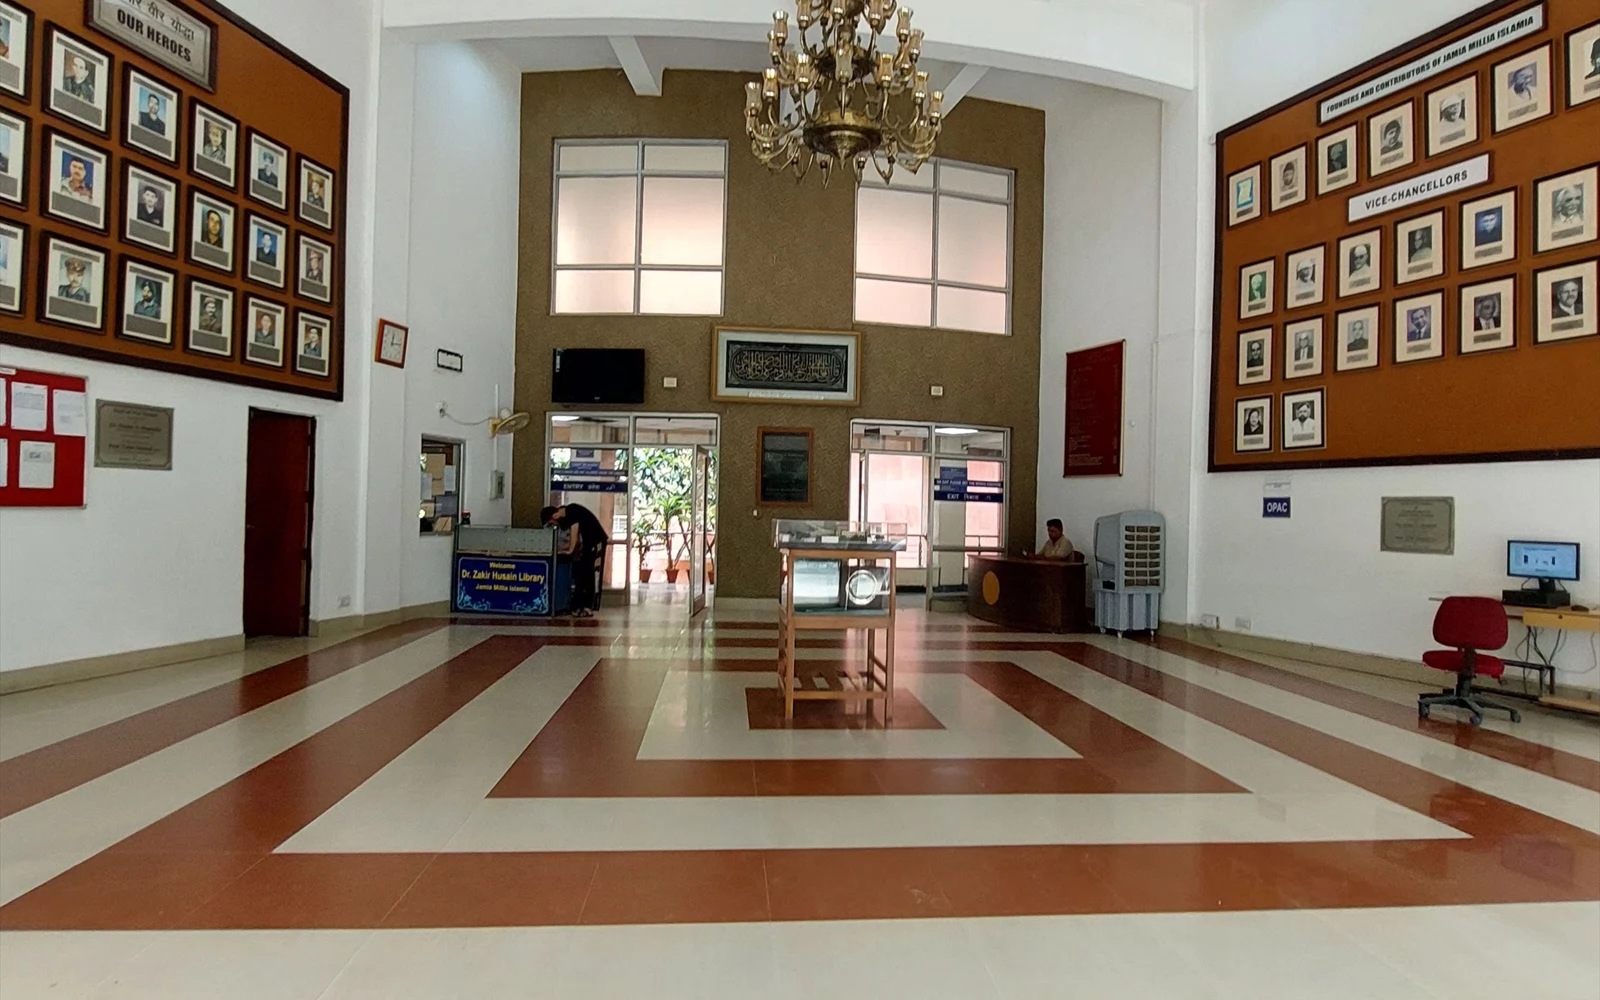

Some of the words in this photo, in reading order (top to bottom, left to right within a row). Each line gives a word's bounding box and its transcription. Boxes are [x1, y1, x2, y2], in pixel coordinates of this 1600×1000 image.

[117, 9, 144, 35] OUR
[146, 25, 192, 62] HEROES
[1326, 93, 1360, 114] FOUNDERS
[1360, 87, 1375, 100] AND
[1375, 62, 1431, 93] CONTRIBUTORS
[1432, 56, 1442, 67] OF
[1443, 45, 1467, 63] JAMIA
[1468, 33, 1496, 52] MILLIA
[1497, 15, 1534, 40] ISLAMIA
[1365, 169, 1468, 211] VICE-CHANCELLORS
[1266, 502, 1288, 513] OPAC
[461, 569, 472, 579] Dr.
[472, 570, 491, 580] Zakir
[492, 571, 517, 581] Husain
[518, 572, 545, 584] Library
